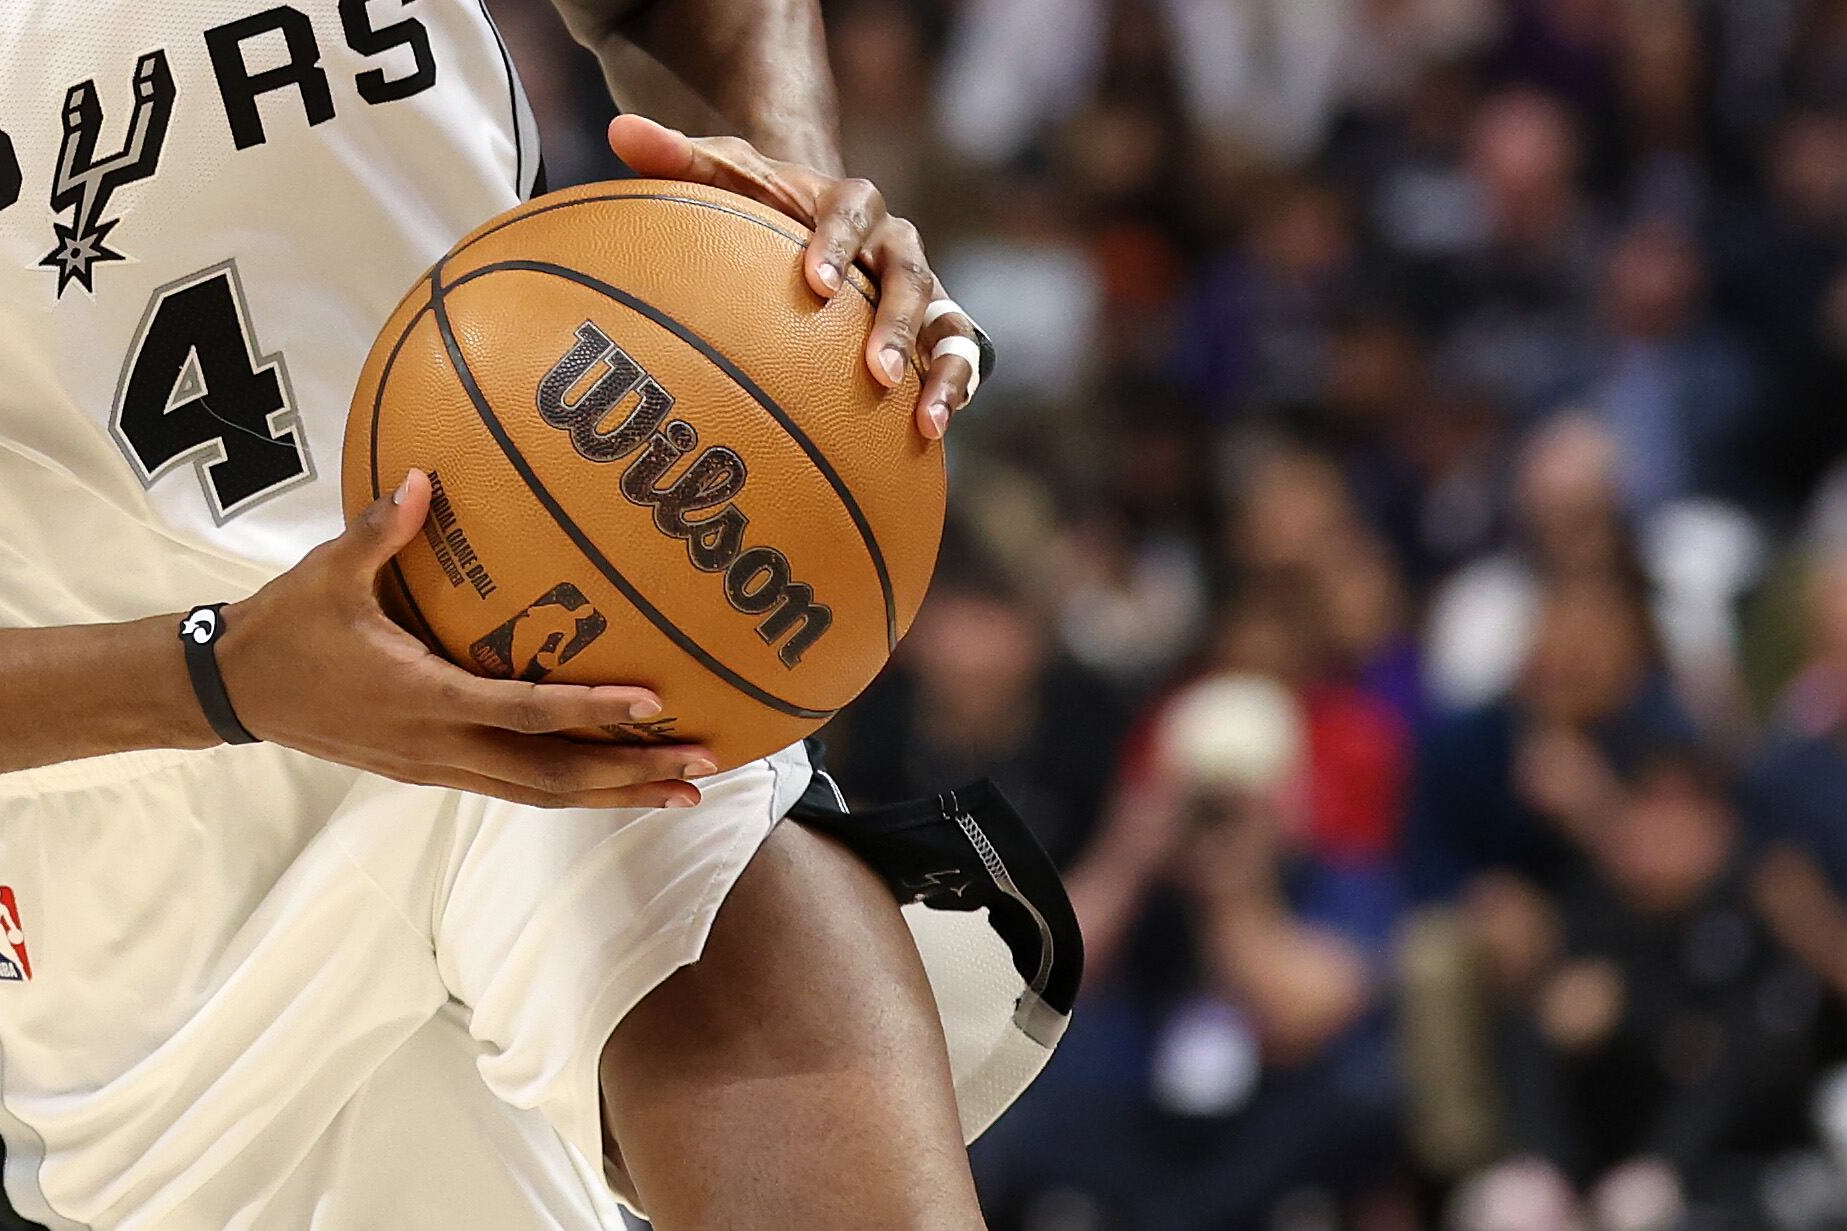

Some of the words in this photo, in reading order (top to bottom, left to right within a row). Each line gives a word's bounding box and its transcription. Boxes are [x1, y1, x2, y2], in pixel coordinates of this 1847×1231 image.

[109, 258, 318, 527] 4
[435, 546, 465, 588] LEATHER
[446, 528, 477, 569] GAME
[466, 564, 496, 600] BALL
[535, 319, 834, 670] Wilson
